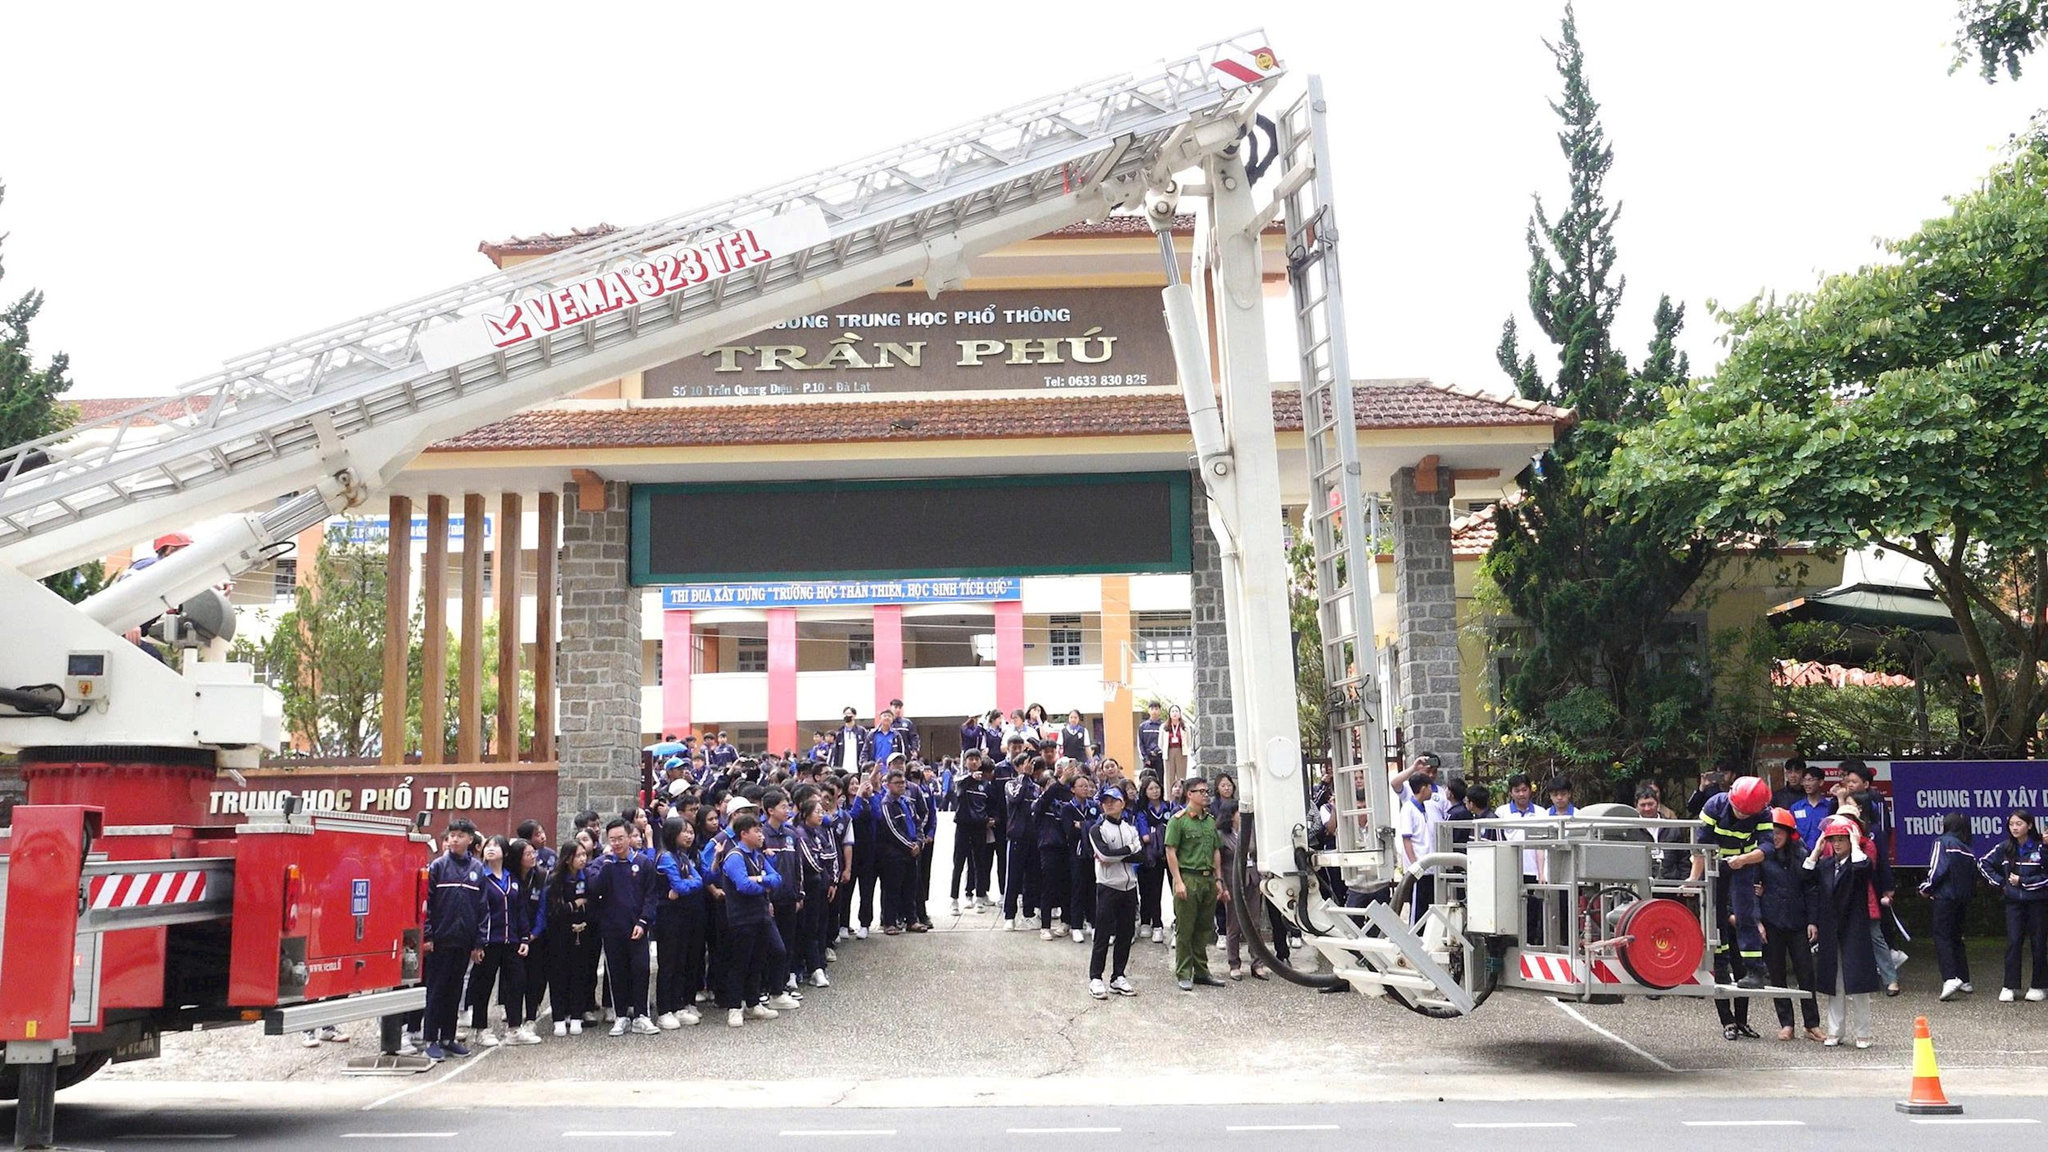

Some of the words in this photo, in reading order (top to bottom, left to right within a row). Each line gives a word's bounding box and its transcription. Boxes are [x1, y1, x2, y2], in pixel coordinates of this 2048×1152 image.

[836, 312, 900, 328] TRUNG
[907, 312, 947, 329] HỌC
[954, 304, 996, 324] PHỔ
[1003, 305, 1070, 324] THÔNG
[702, 332, 927, 373] TRẦN
[956, 326, 1118, 366] PHÚ
[672, 384, 687, 396] Số
[690, 385, 703, 396] 10
[707, 384, 731, 396] Trần
[734, 385, 767, 397] Quang
[803, 382, 825, 393] P.10
[836, 381, 850, 393] Đà
[854, 381, 871, 394] Lạt
[1044, 376, 1064, 388] Tel:
[1068, 375, 1097, 387] 0633
[1100, 375, 1122, 386] 830
[1126, 374, 1148, 386] 825
[671, 589, 689, 603] THI
[691, 589, 713, 602] ĐUA
[713, 586, 735, 602] XÂY
[737, 586, 766, 604] DỰNG
[817, 586, 838, 602] HỌC
[840, 581, 868, 599] THÂN
[907, 584, 930, 600] HỌC
[932, 582, 957, 597] SINH
[959, 579, 984, 596] TÍCH
[360, 776, 413, 811] PHỔ
[423, 782, 510, 810] THÔNG
[1916, 789, 1970, 809] CHUNG
[1974, 789, 2002, 808] TAY
[2007, 785, 2037, 808] XÂY
[1904, 812, 1944, 835] TRƯỜ
[1971, 815, 2002, 838] HỌC
